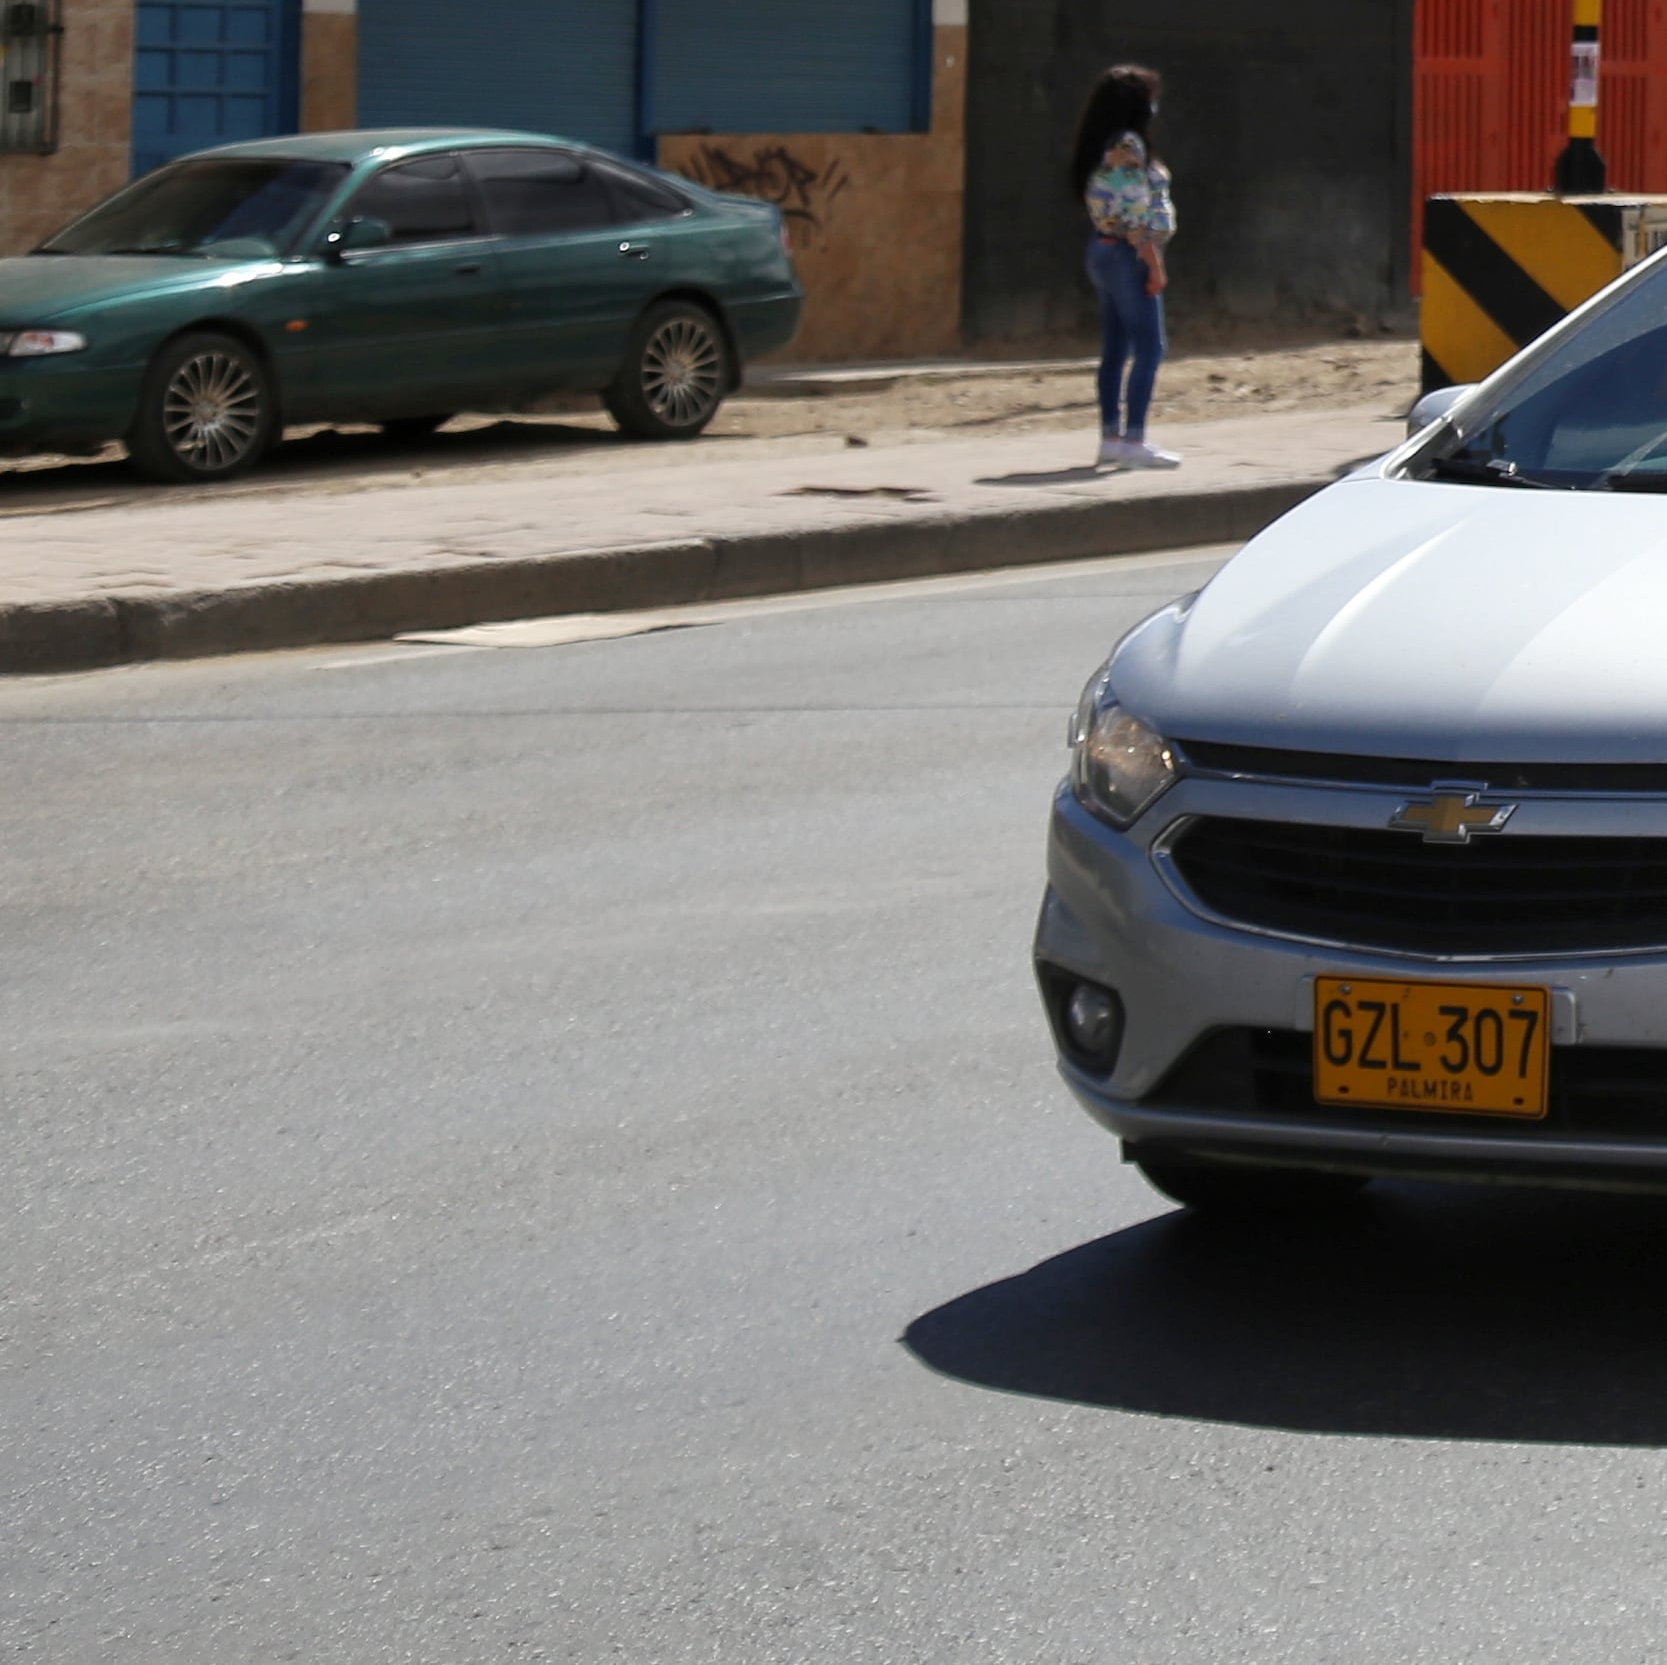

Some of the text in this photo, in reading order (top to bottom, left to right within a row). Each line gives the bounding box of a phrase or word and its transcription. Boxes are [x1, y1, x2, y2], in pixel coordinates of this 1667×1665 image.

[1322, 999, 1539, 1079] GZL 307
[1386, 1077, 1475, 1102] PALMIRA
